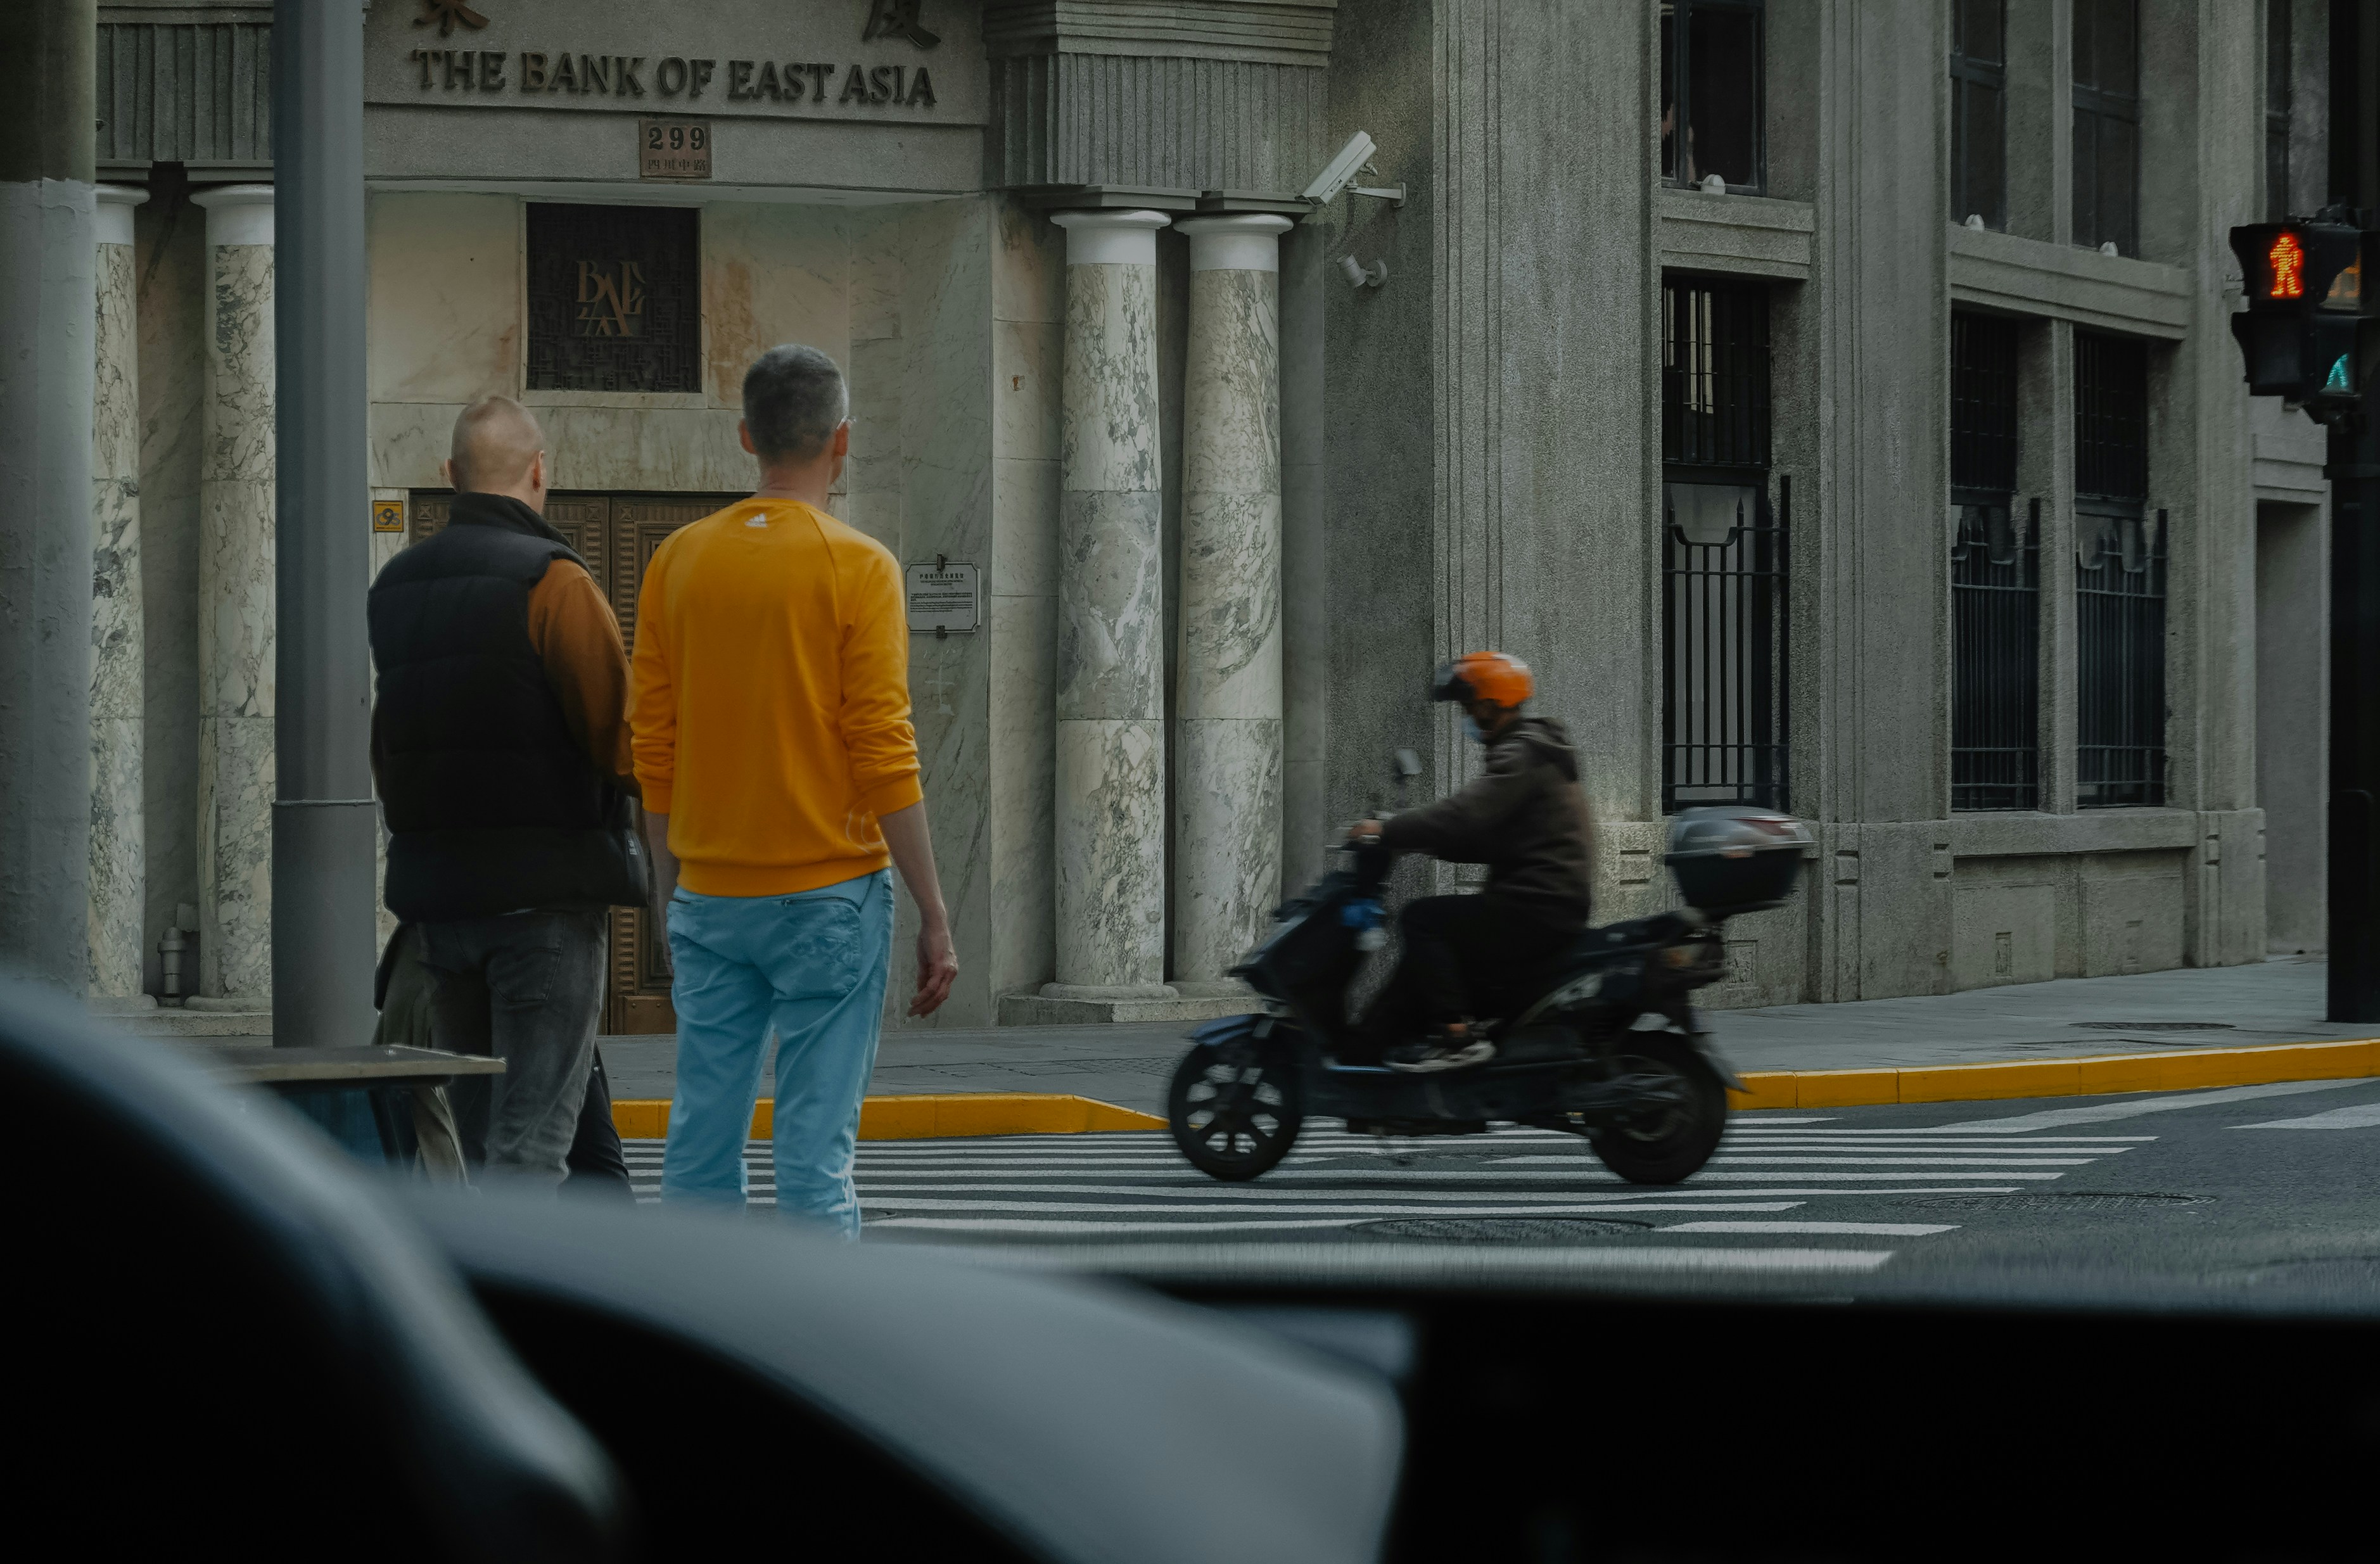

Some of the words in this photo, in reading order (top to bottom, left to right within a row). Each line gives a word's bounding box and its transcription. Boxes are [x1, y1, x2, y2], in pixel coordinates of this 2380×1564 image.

[413, 49, 506, 92] THE
[521, 51, 646, 97] BANK
[656, 56, 716, 98] OF
[728, 60, 835, 104] EAST
[839, 64, 939, 106] ASIA
[648, 127, 705, 150] 299
[648, 159, 706, 171] 四川中路
